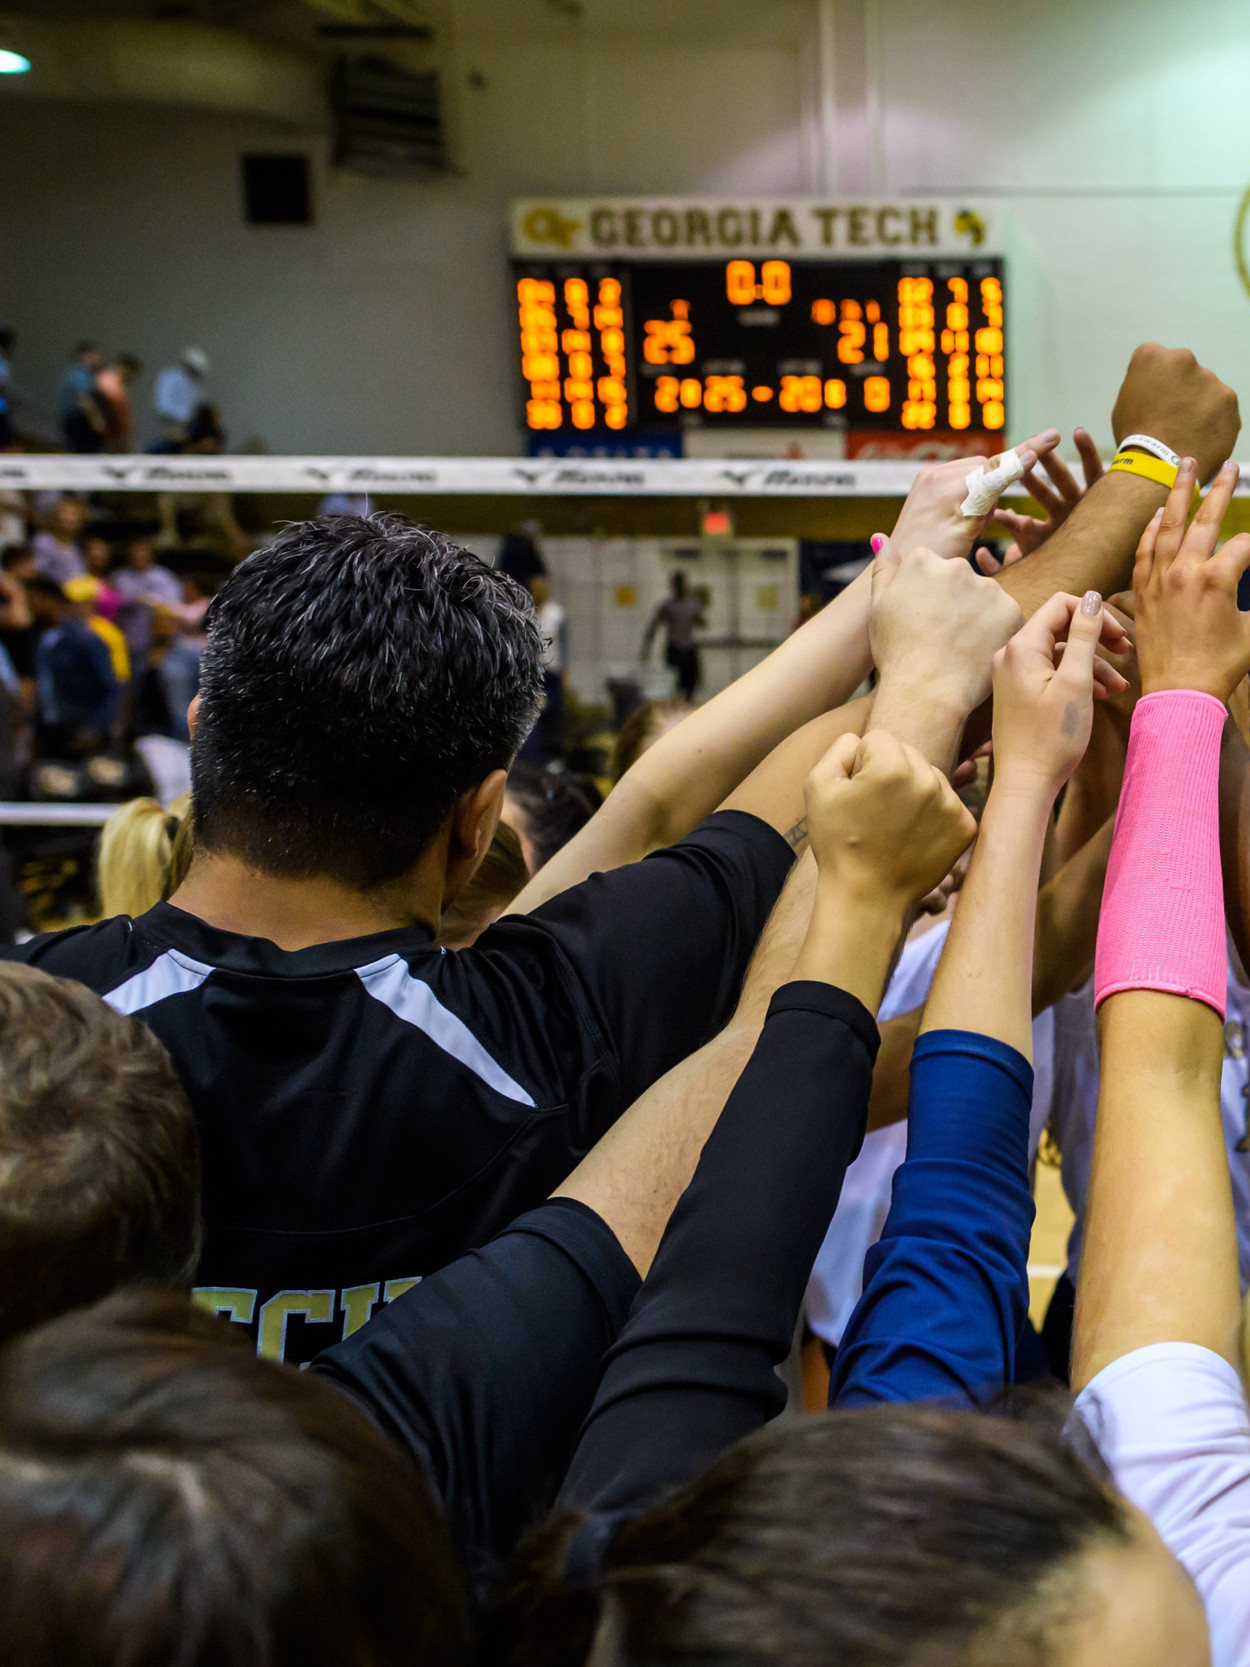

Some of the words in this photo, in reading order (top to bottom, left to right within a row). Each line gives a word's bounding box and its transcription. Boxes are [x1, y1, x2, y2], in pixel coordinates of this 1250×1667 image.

[589, 208, 800, 245] GEORGIA
[814, 208, 939, 245] TECH
[643, 320, 695, 365] 25
[837, 320, 889, 364] 21
